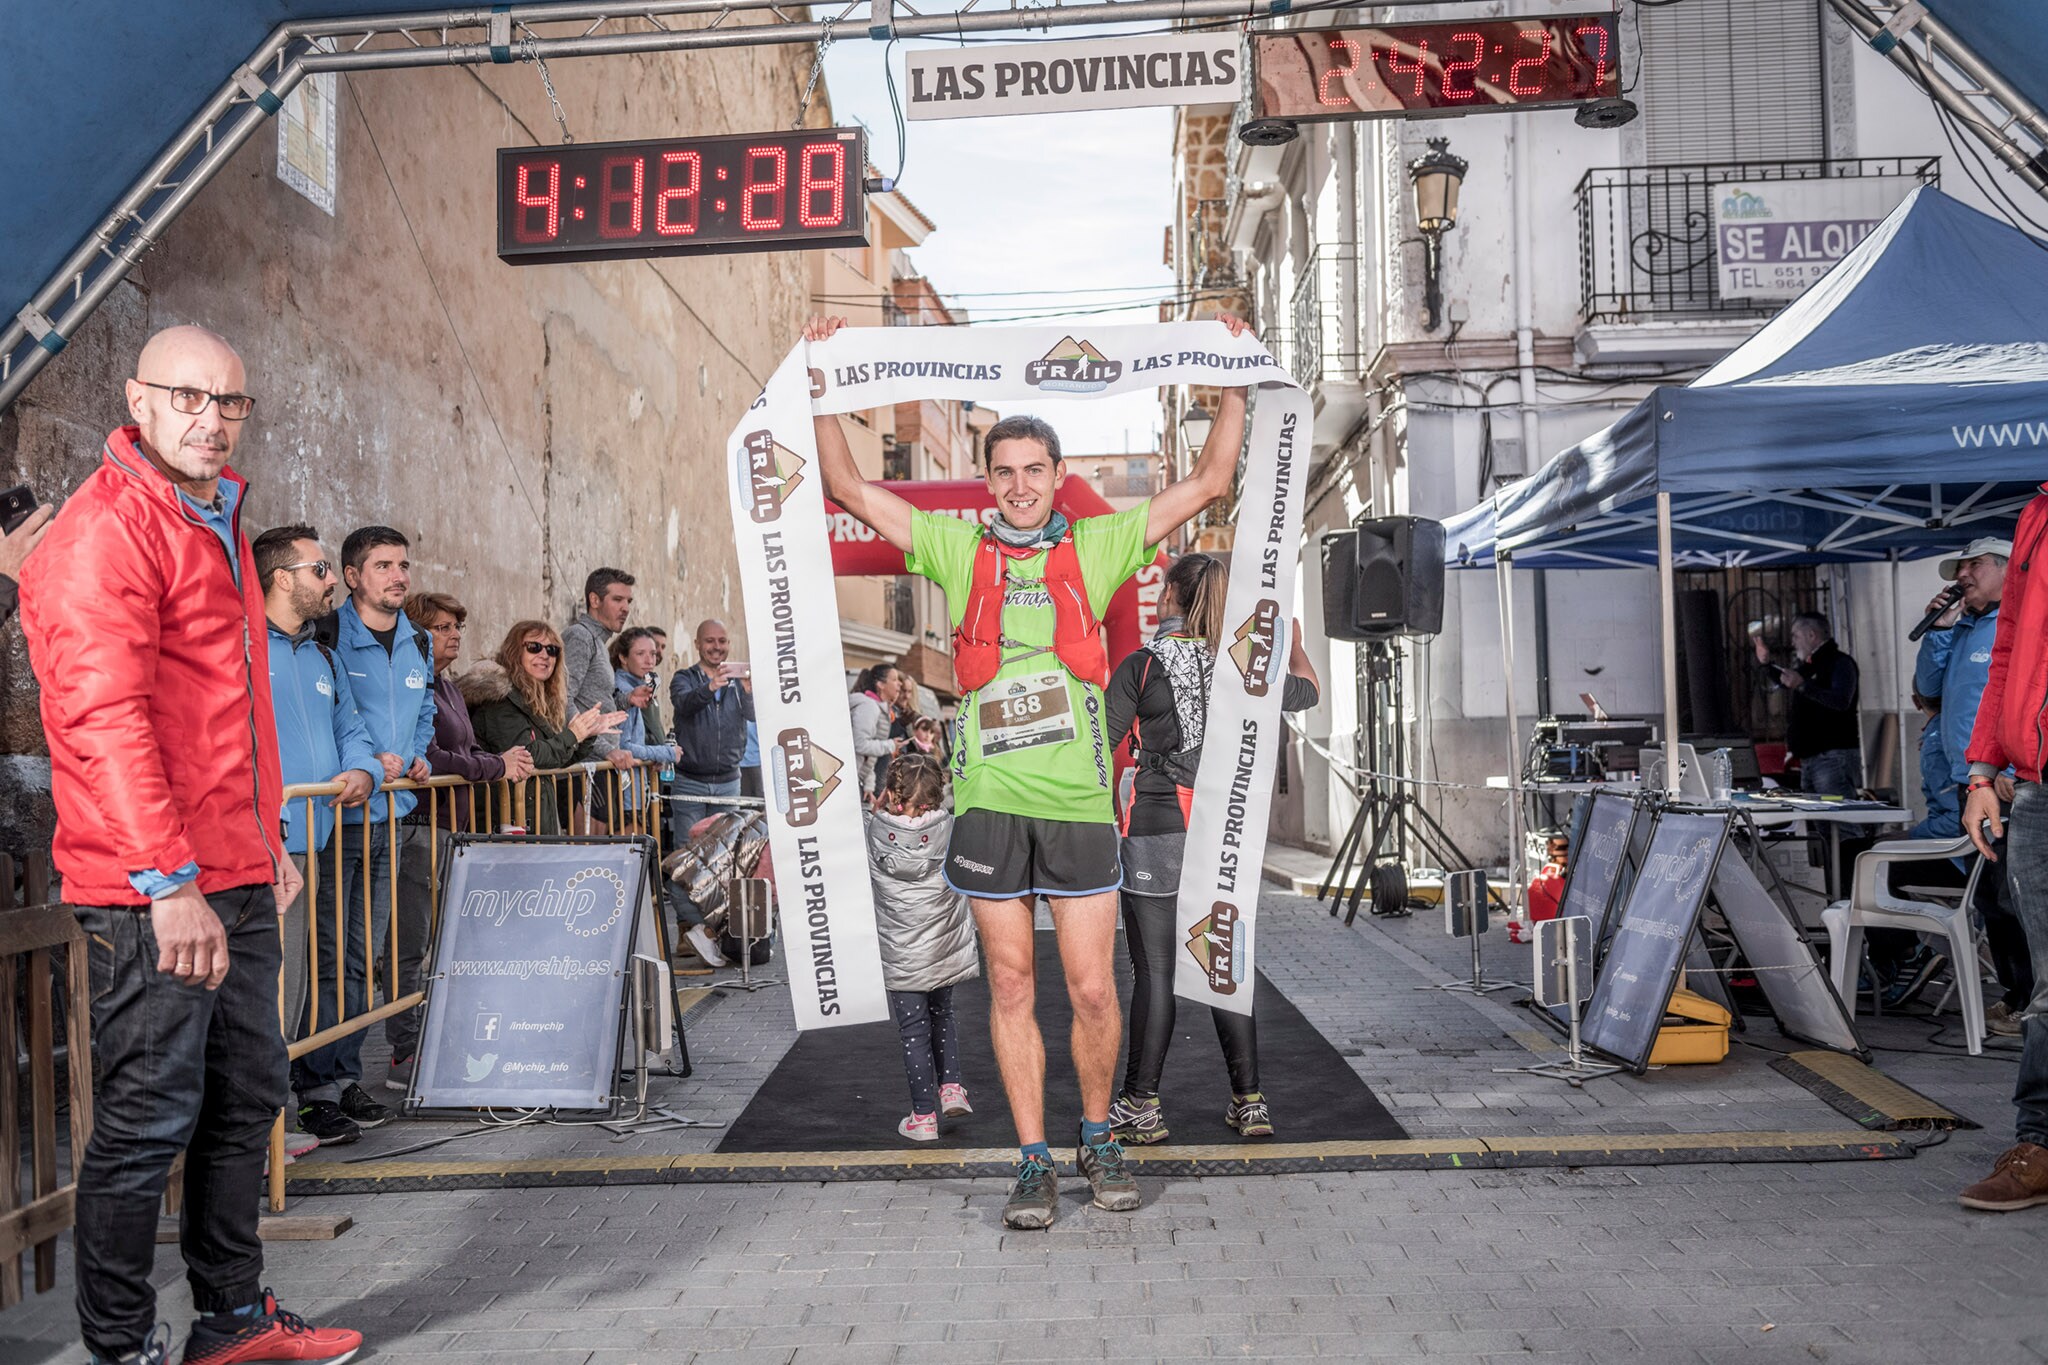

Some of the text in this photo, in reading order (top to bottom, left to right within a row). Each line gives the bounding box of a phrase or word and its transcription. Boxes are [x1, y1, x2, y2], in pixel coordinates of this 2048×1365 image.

[912, 49, 1237, 103] LAS PROVINCIAS
[1319, 26, 1608, 106] 2:42:27
[517, 142, 846, 237] 4:12:28
[1726, 226, 1766, 261] SE
[1774, 266, 1804, 277] 651
[1775, 278, 1806, 289] 964
[835, 362, 870, 388] LAS
[874, 361, 1002, 381] PROVINCIAS
[1131, 354, 1173, 373] LAS
[1261, 412, 1298, 590] LAS PROVINCIAS
[762, 531, 802, 705] LAS PROVINCIAS
[1000, 694, 1042, 719] 168
[1217, 719, 1258, 893] LAS PROVINCIAS
[461, 878, 597, 927] mychip
[797, 836, 841, 1017] LAS PROVINCIAS
[451, 955, 611, 980] www.mychip.es
[509, 1021, 565, 1032] /infomychip
[502, 1062, 569, 1074] @Mychip_Info
